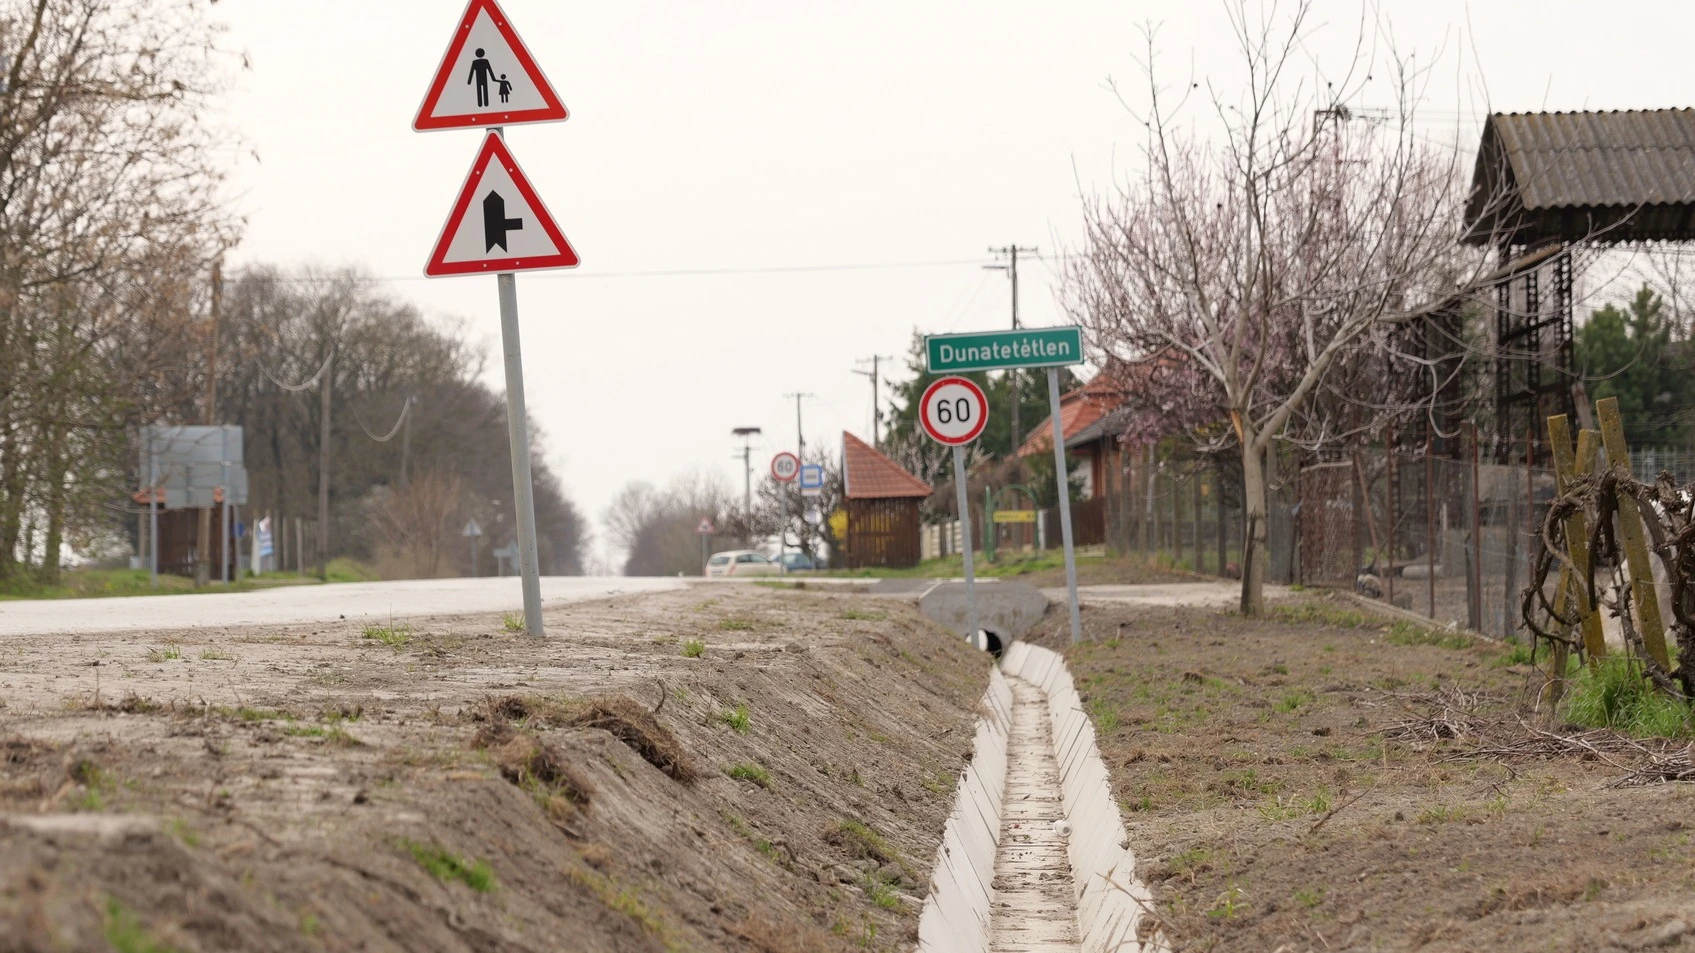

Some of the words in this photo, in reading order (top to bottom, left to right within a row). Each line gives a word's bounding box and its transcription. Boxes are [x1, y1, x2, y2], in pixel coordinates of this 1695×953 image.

[939, 338, 1070, 364] Dunatetétlen
[937, 398, 970, 424] 60
[776, 459, 793, 474] 60
